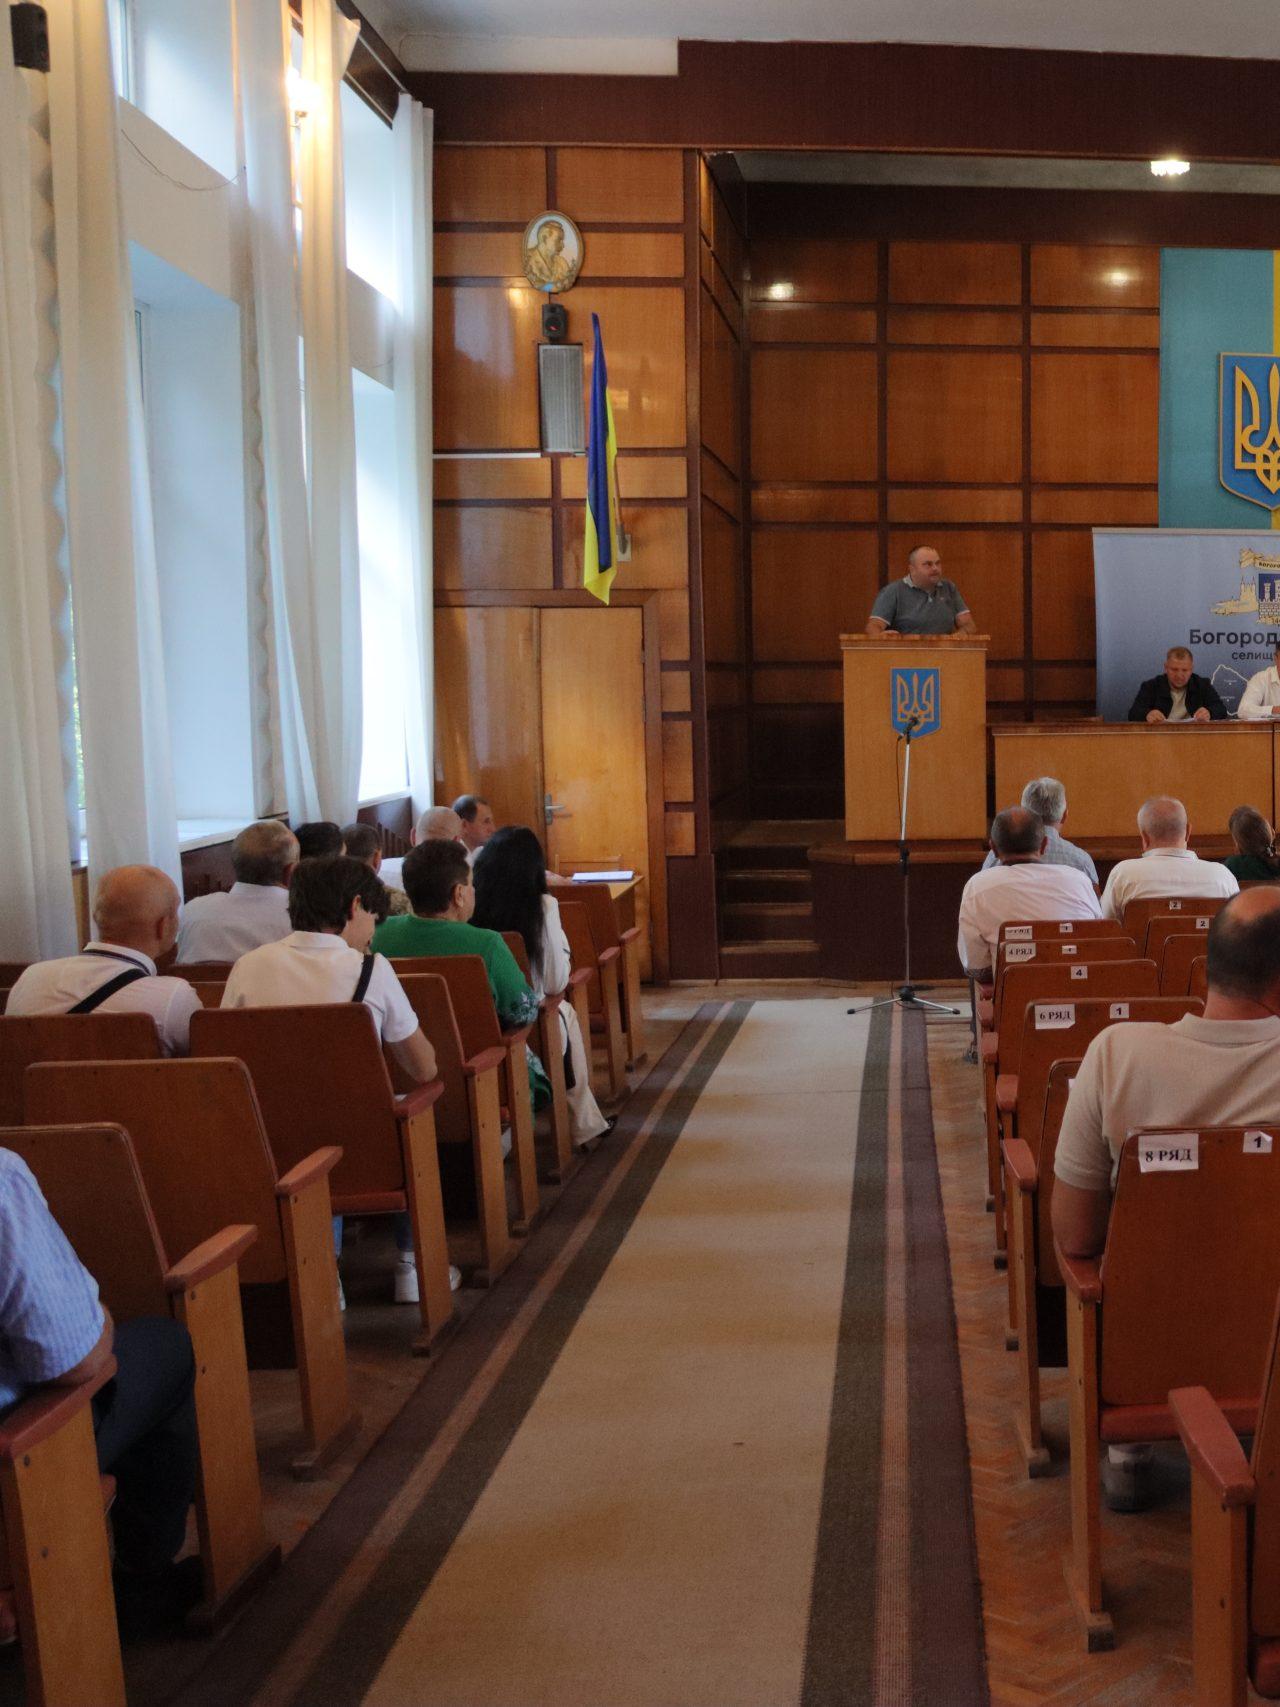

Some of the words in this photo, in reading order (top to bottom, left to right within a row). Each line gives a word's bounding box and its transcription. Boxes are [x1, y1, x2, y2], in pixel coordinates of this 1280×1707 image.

[1231, 651, 1274, 662] селищ
[1039, 1011, 1046, 1020] 6
[1048, 1010, 1072, 1020] РЯД
[1253, 1136, 1262, 1149] 1
[1145, 1151, 1154, 1163] 8
[1159, 1149, 1193, 1163] РЯД
